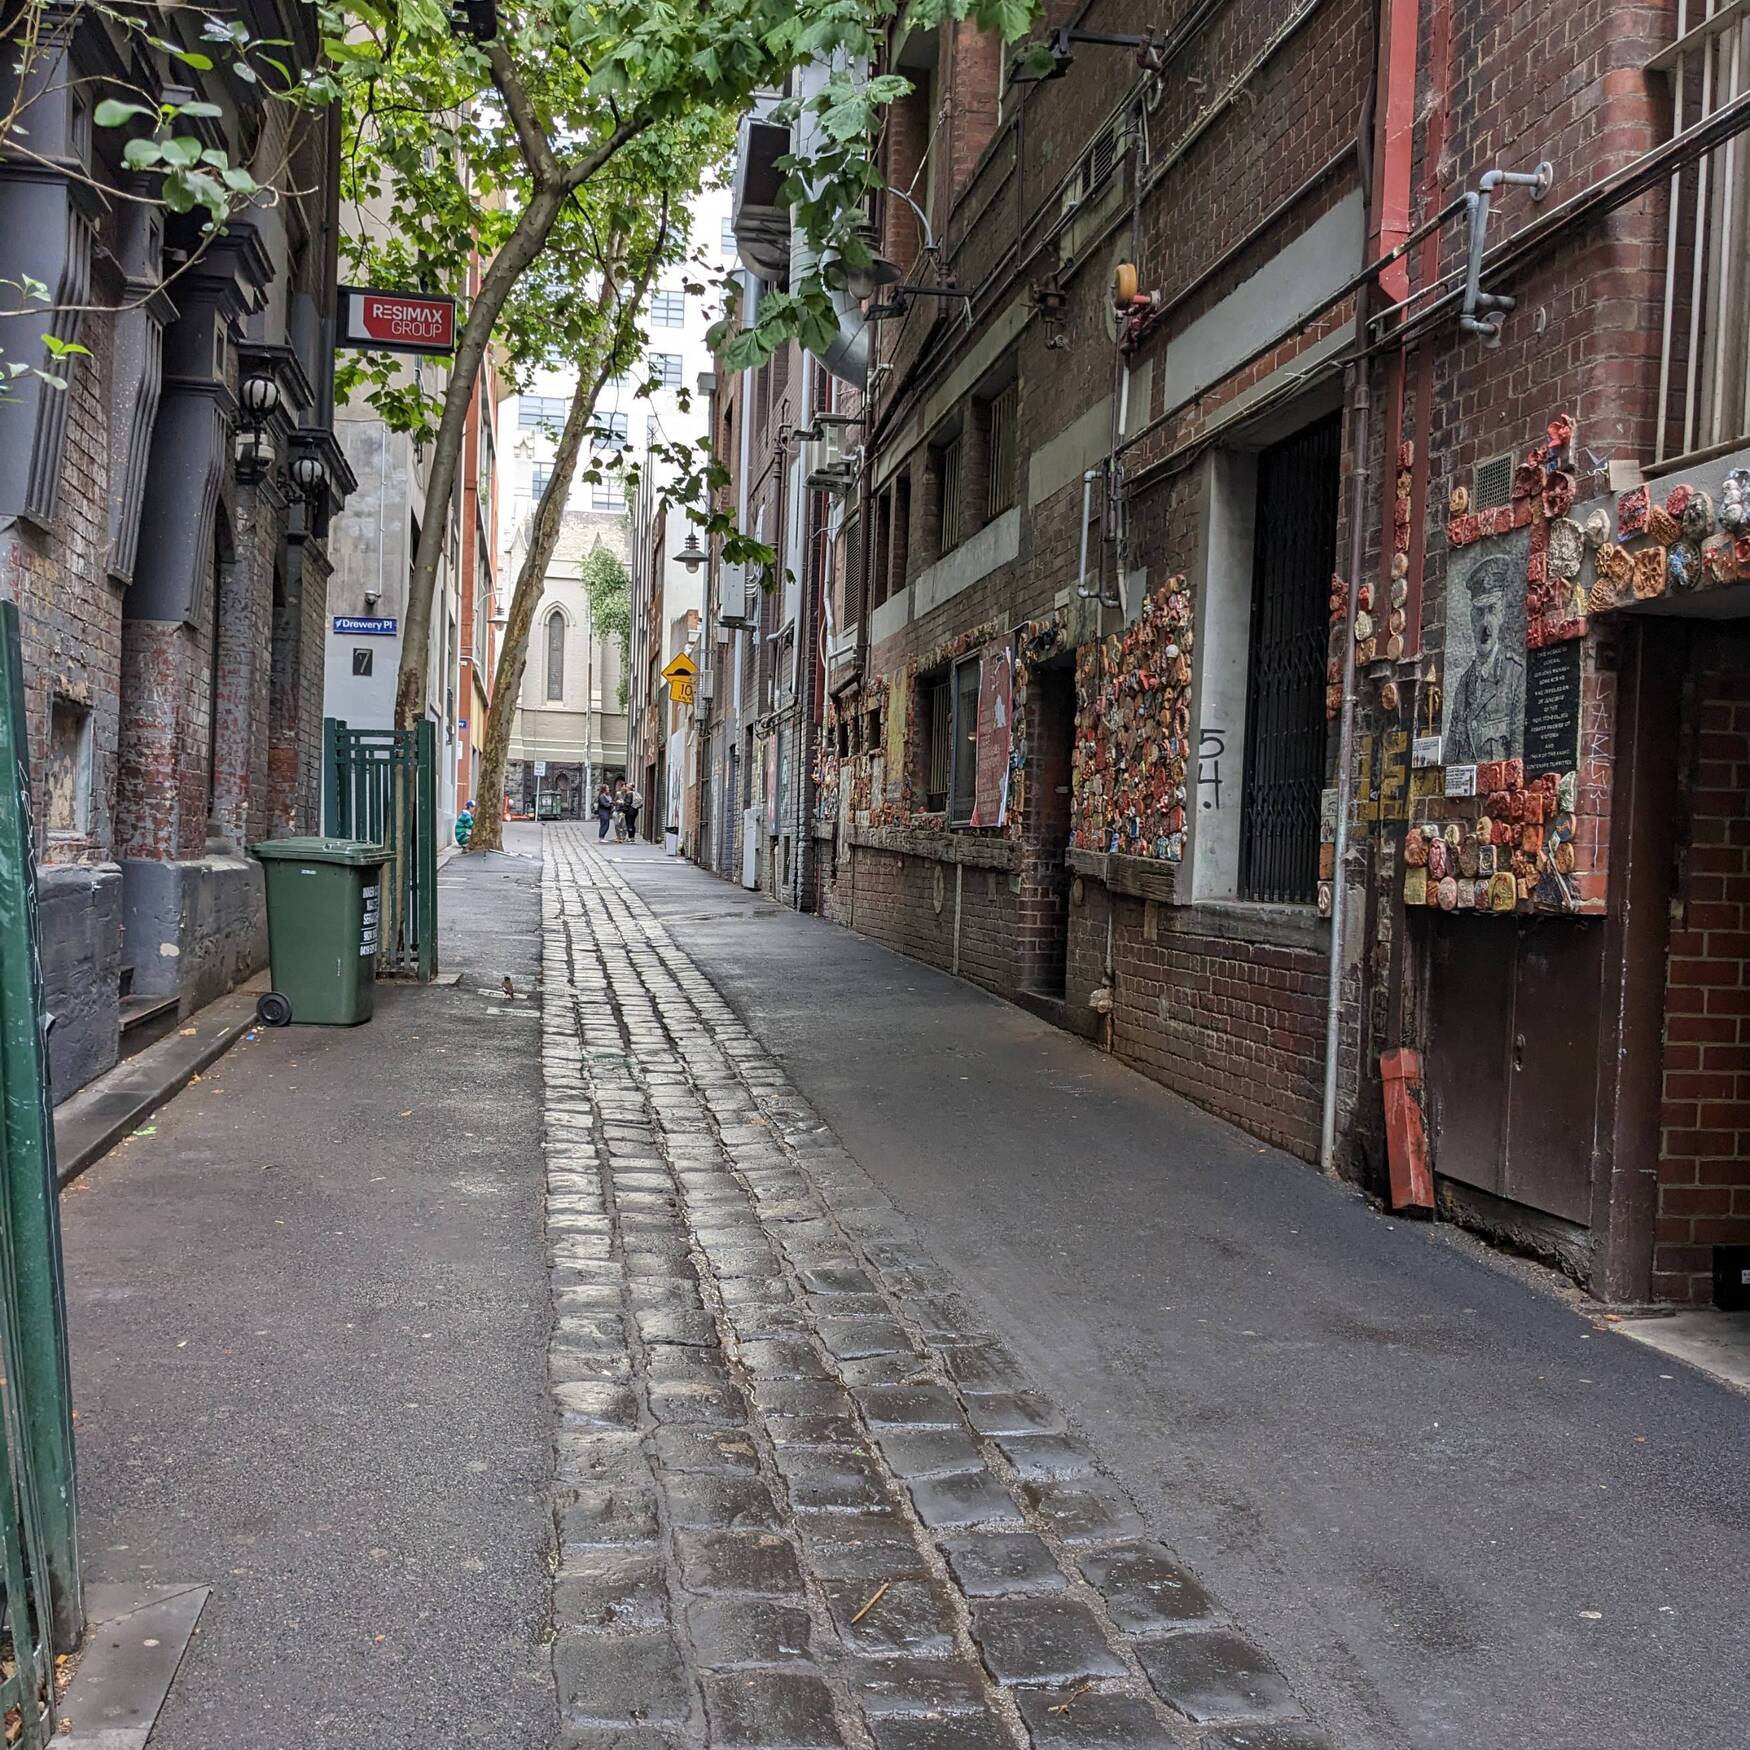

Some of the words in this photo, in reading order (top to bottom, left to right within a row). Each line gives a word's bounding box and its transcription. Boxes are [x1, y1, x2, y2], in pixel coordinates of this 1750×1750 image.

[373, 304, 442, 323] RESIMAX
[391, 320, 442, 337] GROUP
[342, 619, 382, 630] Drewery
[355, 649, 371, 673] 7
[681, 684, 692, 696] 10
